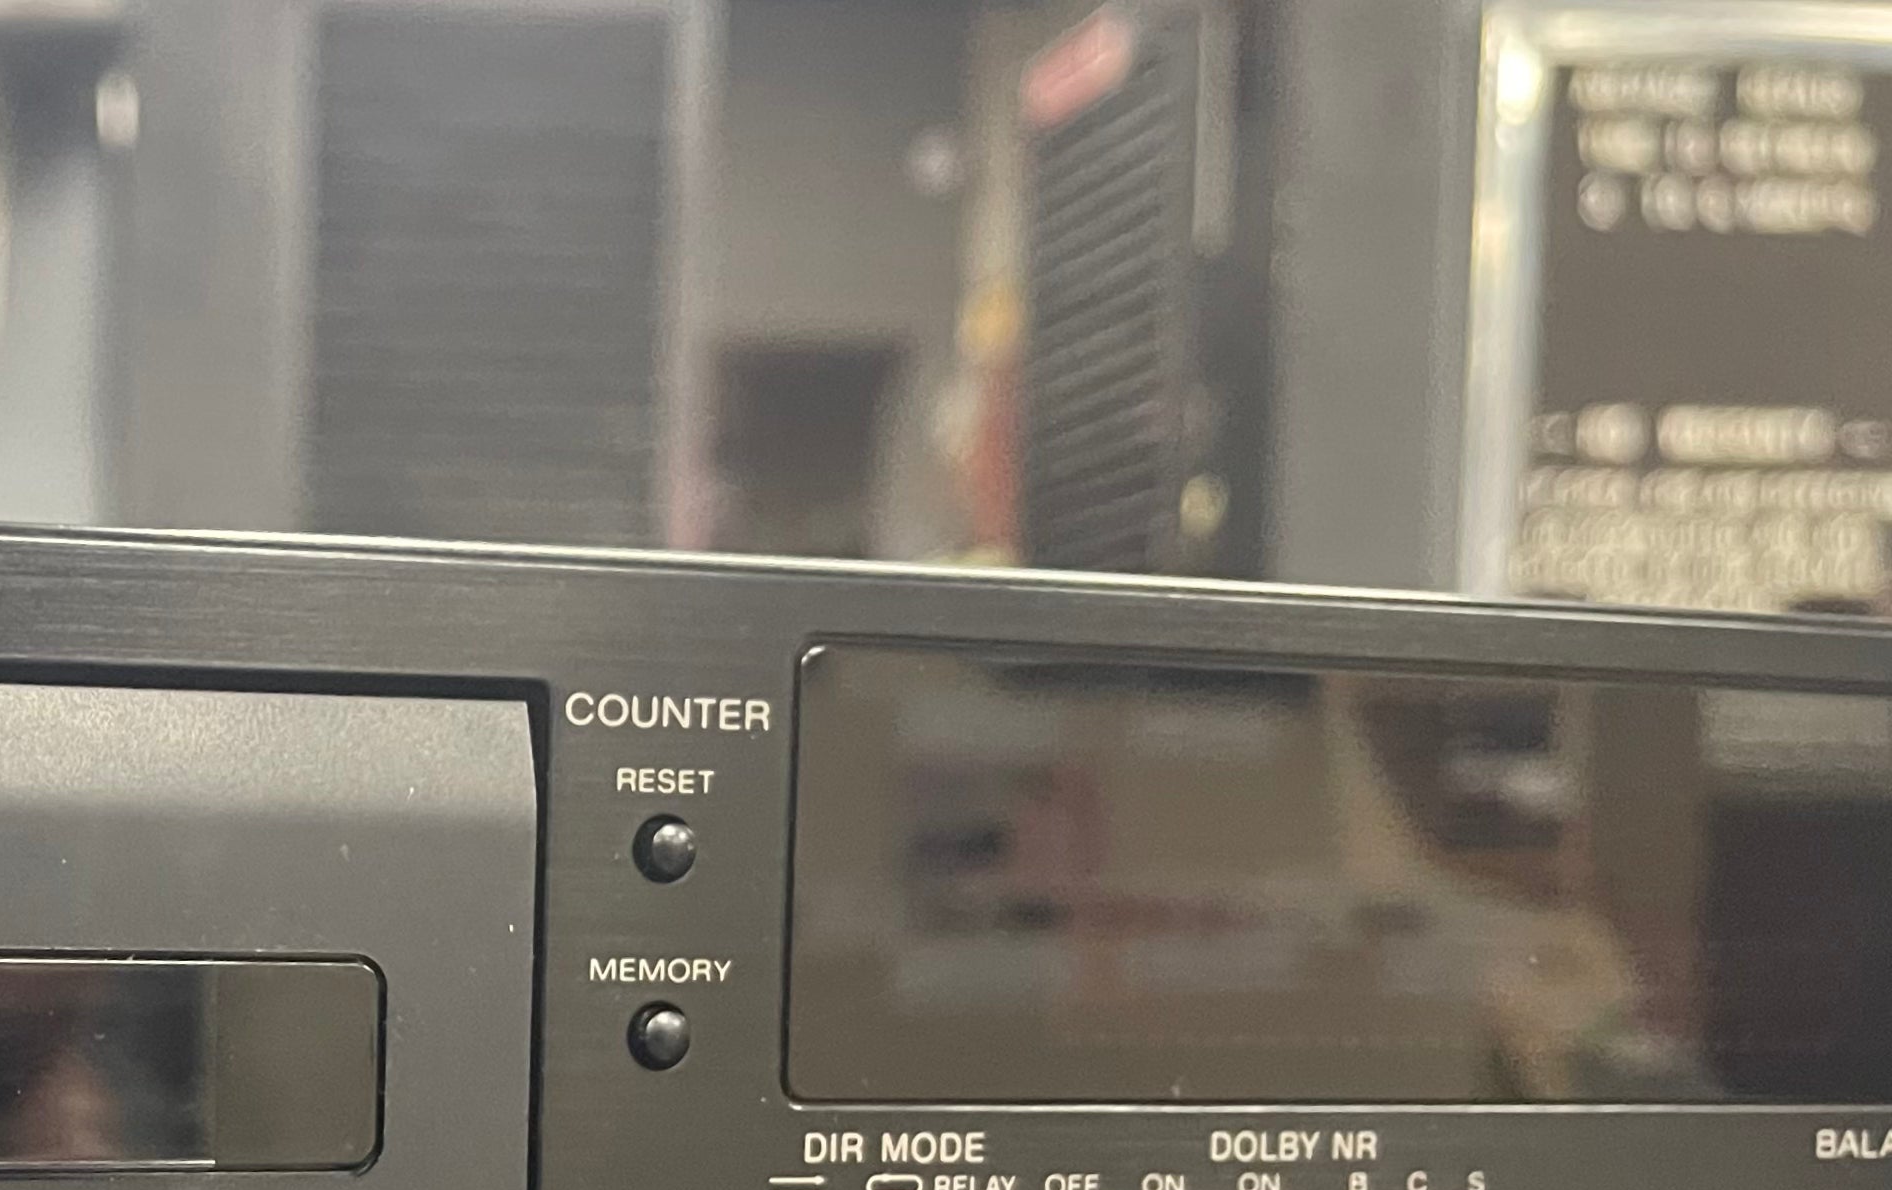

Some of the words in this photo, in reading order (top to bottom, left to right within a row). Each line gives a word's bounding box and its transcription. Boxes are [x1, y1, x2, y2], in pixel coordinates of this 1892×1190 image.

[565, 691, 771, 733] COUNTER
[616, 766, 715, 795] RESET
[589, 957, 731, 984] MEMORY
[804, 1132, 864, 1164] DIR
[881, 1131, 986, 1163] MODE
[1210, 1131, 1320, 1162] DOLBY
[1332, 1131, 1378, 1161] NR
